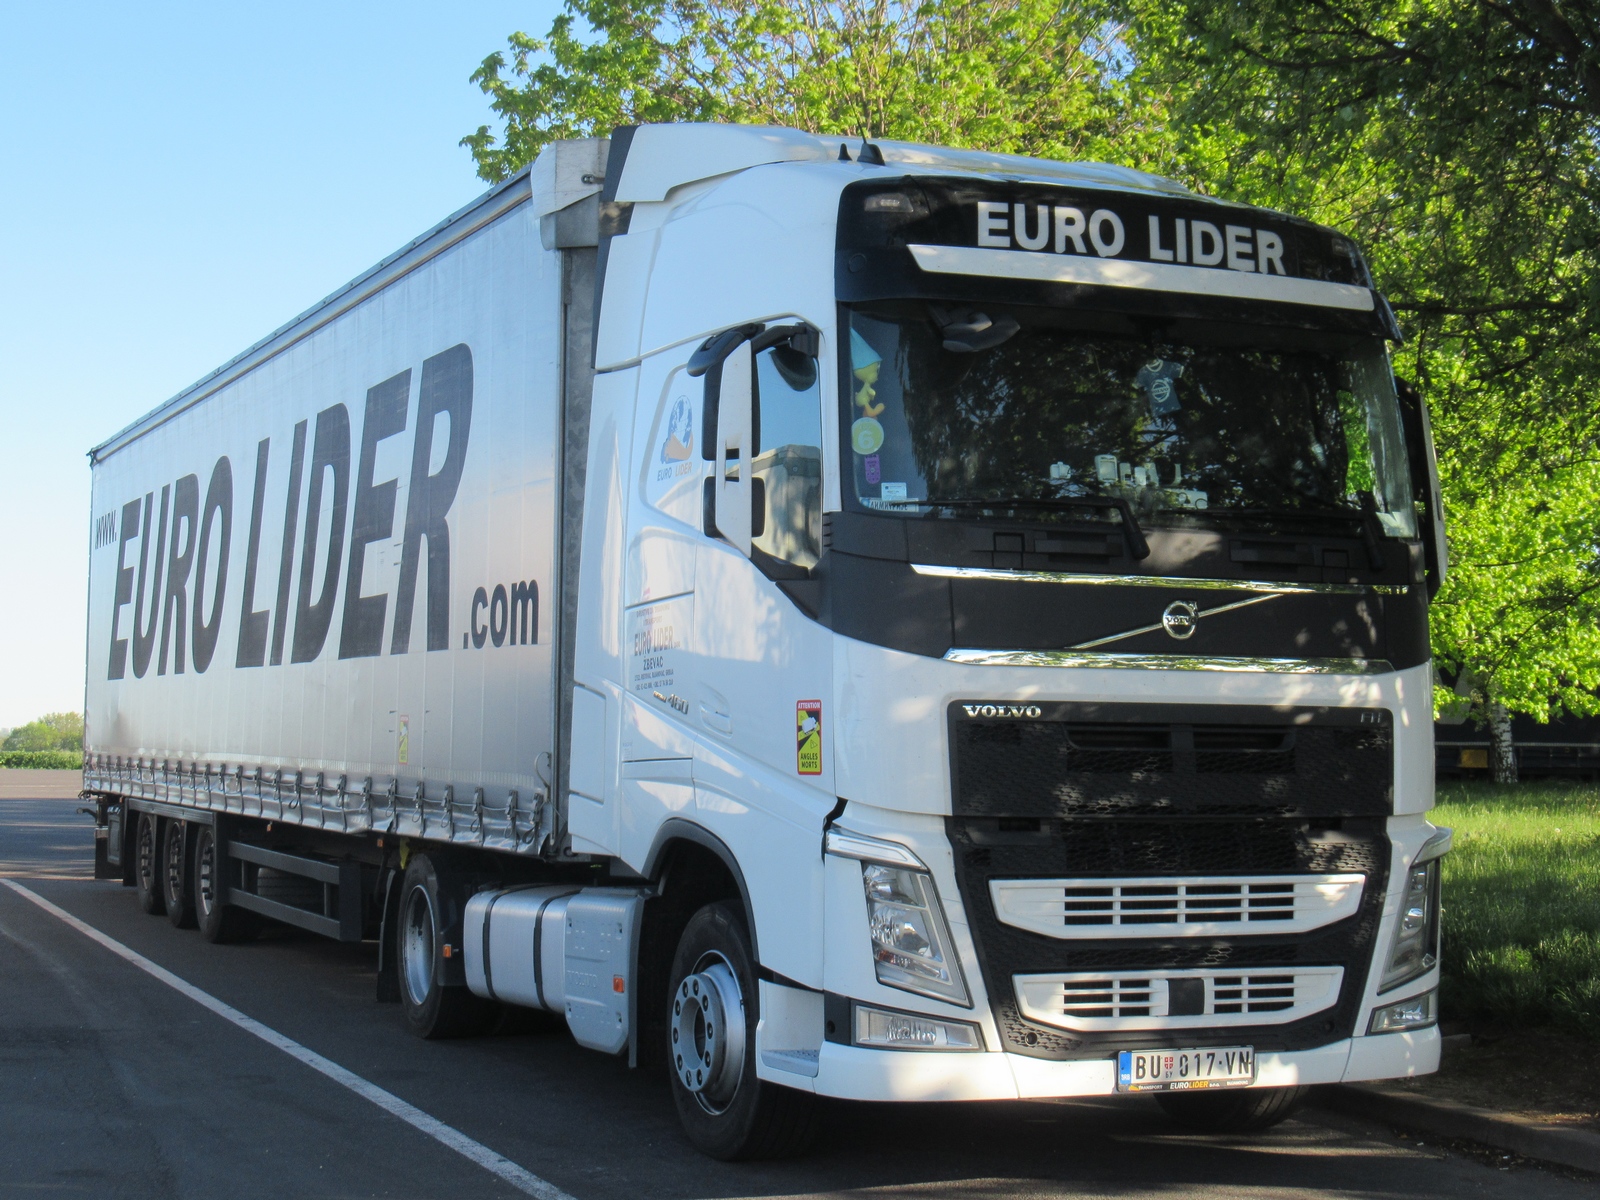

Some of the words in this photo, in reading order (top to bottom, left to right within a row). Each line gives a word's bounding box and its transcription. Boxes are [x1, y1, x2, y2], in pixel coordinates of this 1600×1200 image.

[977, 201, 1125, 258] EURO
[1148, 215, 1287, 276] LIDER
[858, 430, 874, 449] 6
[657, 467, 673, 481] EURO
[675, 461, 693, 477] LIDER
[95, 508, 117, 550] www.
[107, 455, 234, 681] EURO
[235, 342, 474, 669] LIDER
[463, 579, 539, 649] .com
[1165, 615, 1195, 624] VOLVO
[634, 630, 652, 657] EURO
[653, 625, 674, 653] LIDER
[963, 705, 1042, 719] VOLVO
[801, 761, 818, 769] MORTS
[1136, 1055, 1161, 1079] BU
